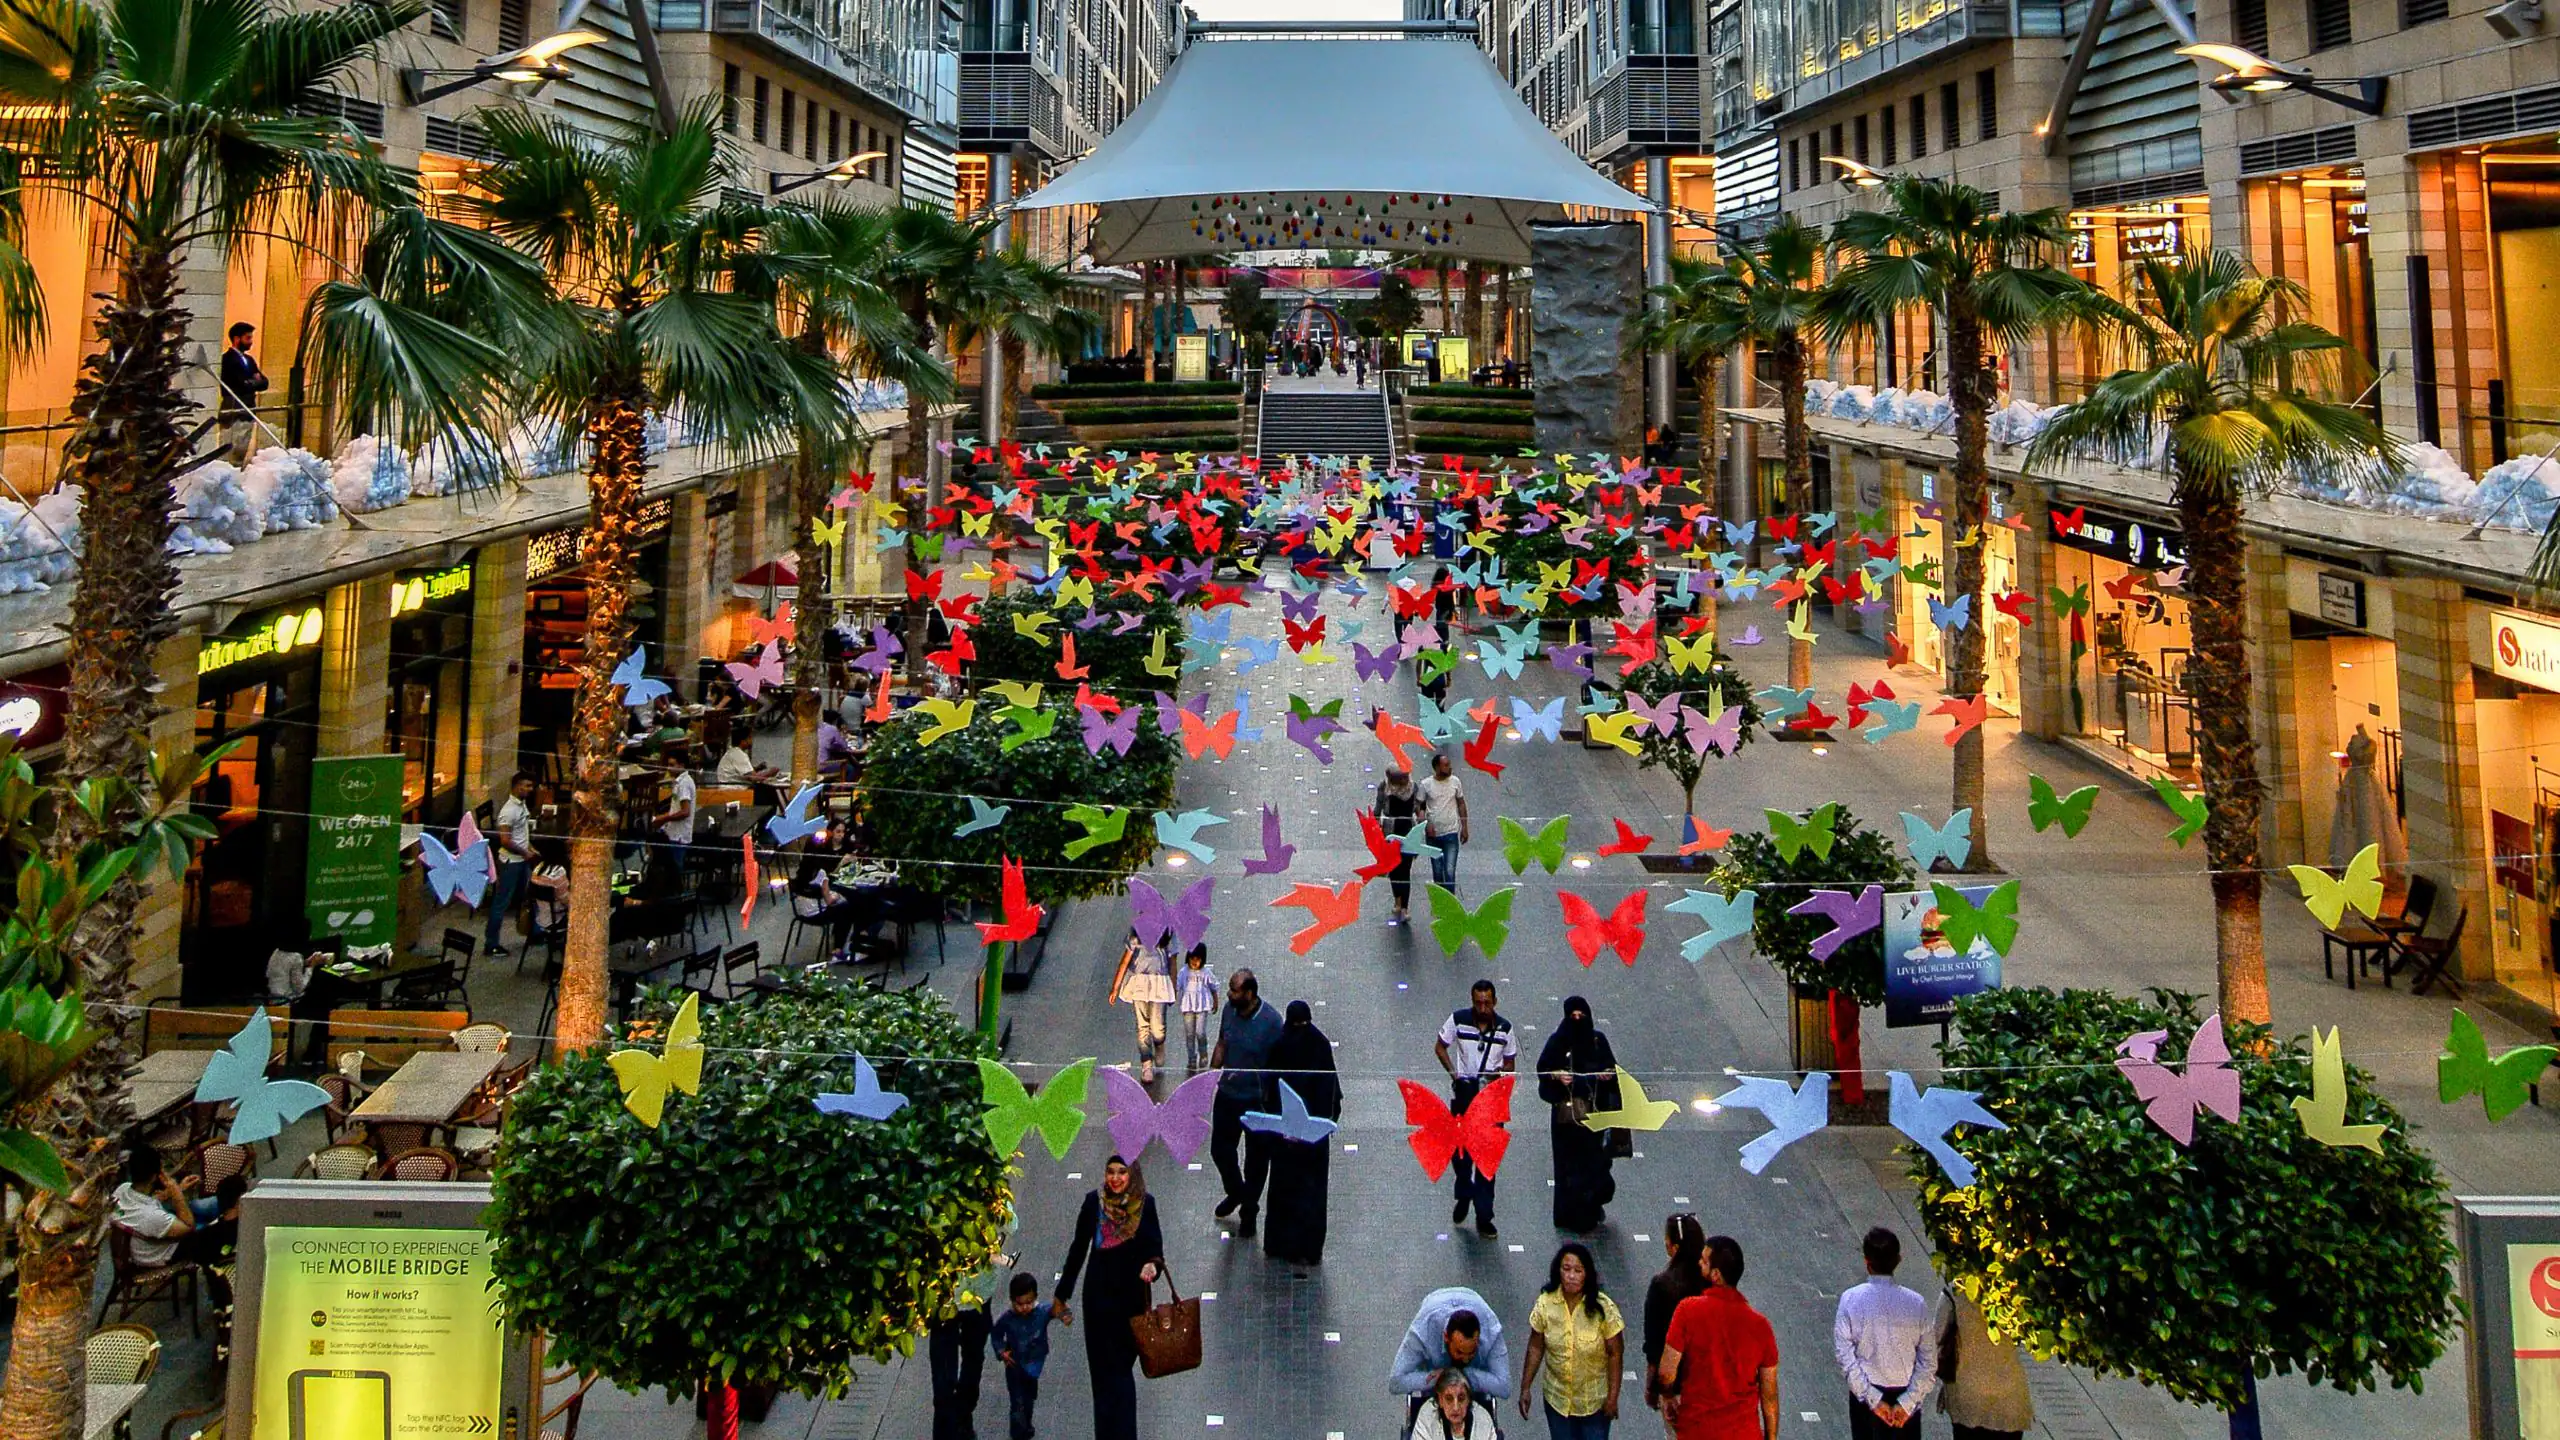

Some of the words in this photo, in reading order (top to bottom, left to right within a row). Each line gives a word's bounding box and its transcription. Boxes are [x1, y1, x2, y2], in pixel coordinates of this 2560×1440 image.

[319, 818, 345, 831] WE
[347, 814, 391, 829] OPEN
[335, 834, 373, 849] 24/7
[1896, 966, 1917, 976] LIVE
[1918, 963, 1954, 975] BURGER
[1955, 960, 1993, 972] STATION
[1920, 975, 1934, 983] Chef
[291, 1240, 366, 1256] CONNECT
[370, 1241, 389, 1256] TO
[393, 1241, 480, 1256] EXPERIENCE
[300, 1261, 325, 1275] THE
[328, 1258, 397, 1275] MOBILE
[402, 1259, 469, 1276] BRIDGE
[346, 1289, 370, 1300] How
[373, 1288, 380, 1299] it
[382, 1290, 419, 1301] works?
[407, 1414, 421, 1423] Tap
[435, 1414, 451, 1422] NFC
[398, 1424, 417, 1433] Scan
[419, 1424, 431, 1432] the
[432, 1425, 443, 1434] QR
[445, 1425, 465, 1433] code
